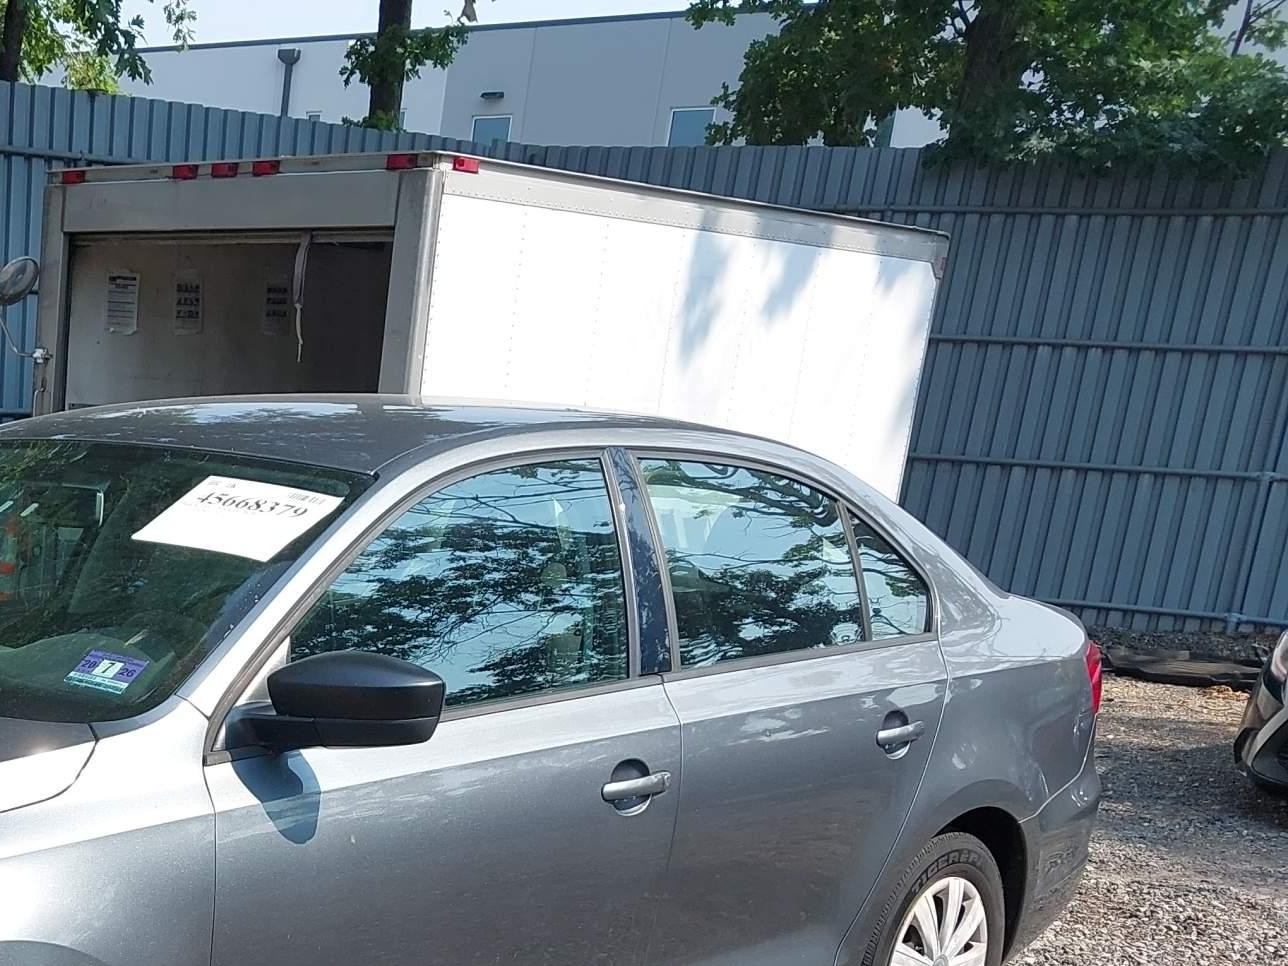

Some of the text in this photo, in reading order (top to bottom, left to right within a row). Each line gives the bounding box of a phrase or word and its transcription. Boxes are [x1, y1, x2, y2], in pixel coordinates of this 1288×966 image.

[197, 491, 309, 519] 45668379
[81, 659, 98, 671] 20
[118, 667, 137, 678] 26
